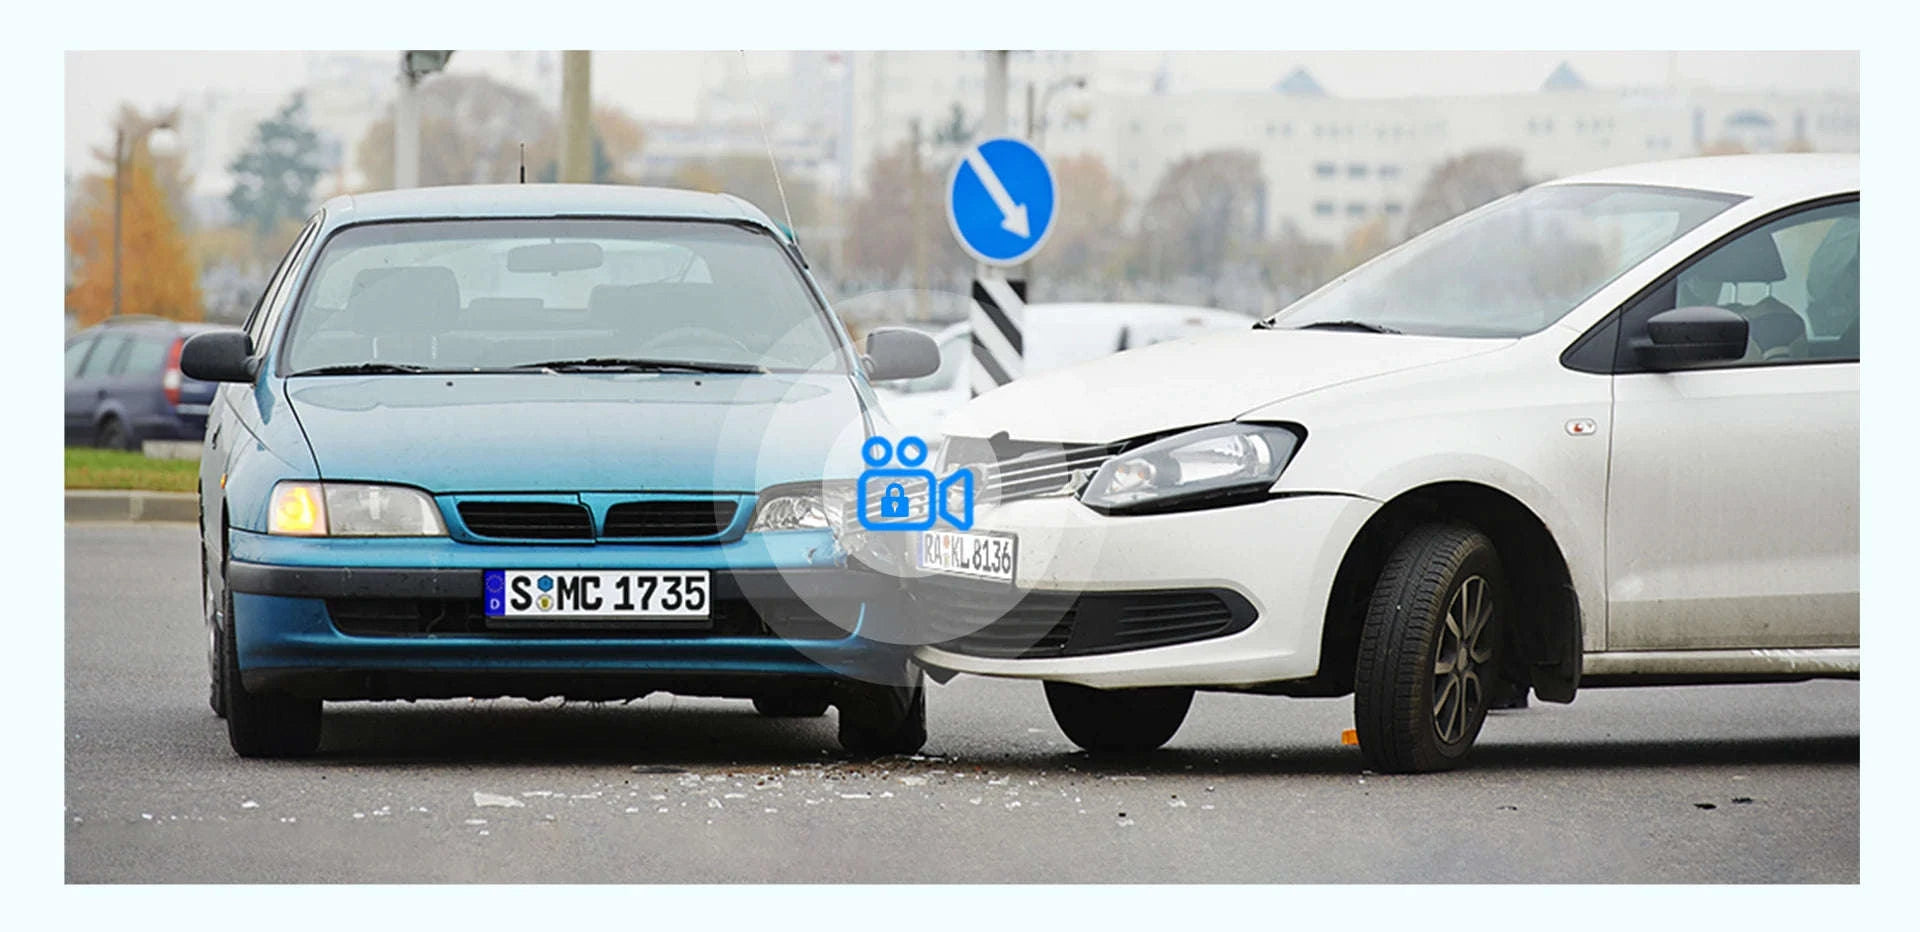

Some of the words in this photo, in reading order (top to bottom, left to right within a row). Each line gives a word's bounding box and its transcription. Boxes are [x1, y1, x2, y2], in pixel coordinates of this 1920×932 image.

[924, 534, 942, 566] RA
[951, 535, 970, 569] KL
[972, 538, 1011, 574] 8136
[510, 575, 533, 611] S
[557, 576, 603, 610] MC
[614, 576, 706, 611] 1735
